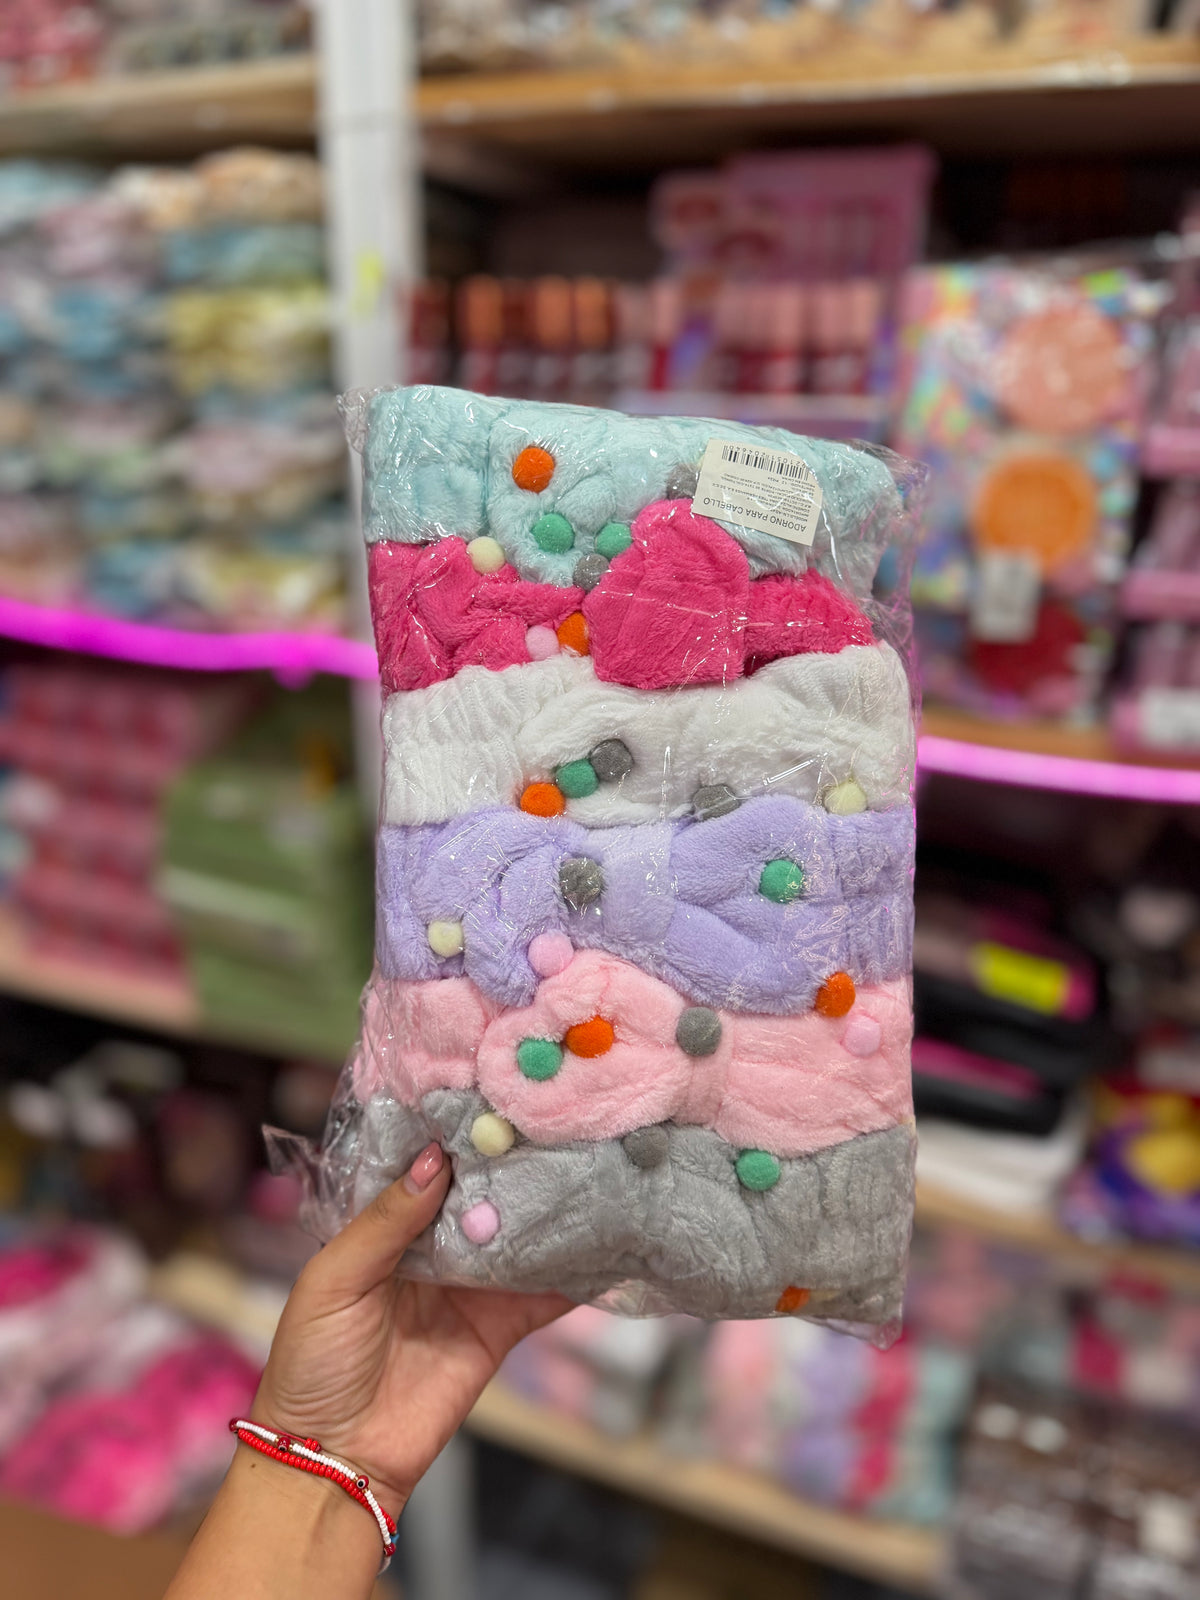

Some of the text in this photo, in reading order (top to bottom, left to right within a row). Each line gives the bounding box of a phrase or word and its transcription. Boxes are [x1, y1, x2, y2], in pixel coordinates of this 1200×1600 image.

[702, 496, 744, 515] CABELLO
[744, 508, 768, 521] PARA
[769, 515, 806, 532] ADORNO
